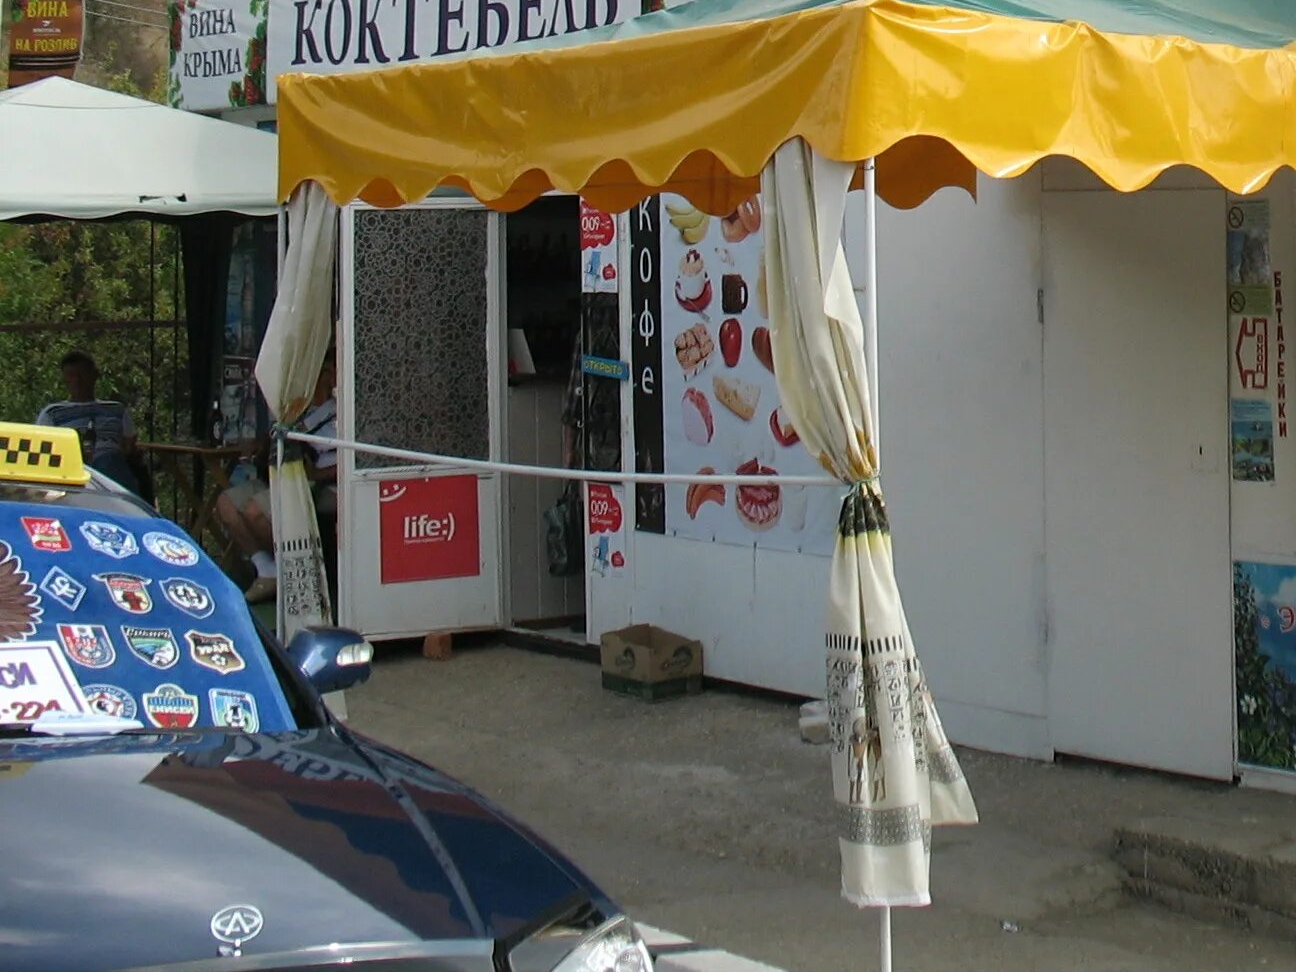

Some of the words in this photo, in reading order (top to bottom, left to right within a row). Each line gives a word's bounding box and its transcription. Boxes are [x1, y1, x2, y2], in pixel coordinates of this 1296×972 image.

[27, 0, 69, 18] ВИНА
[189, 8, 237, 38] ВИНА
[183, 48, 242, 78] КРЫМА
[1273, 271, 1288, 438] БАТАРЕЙКИ
